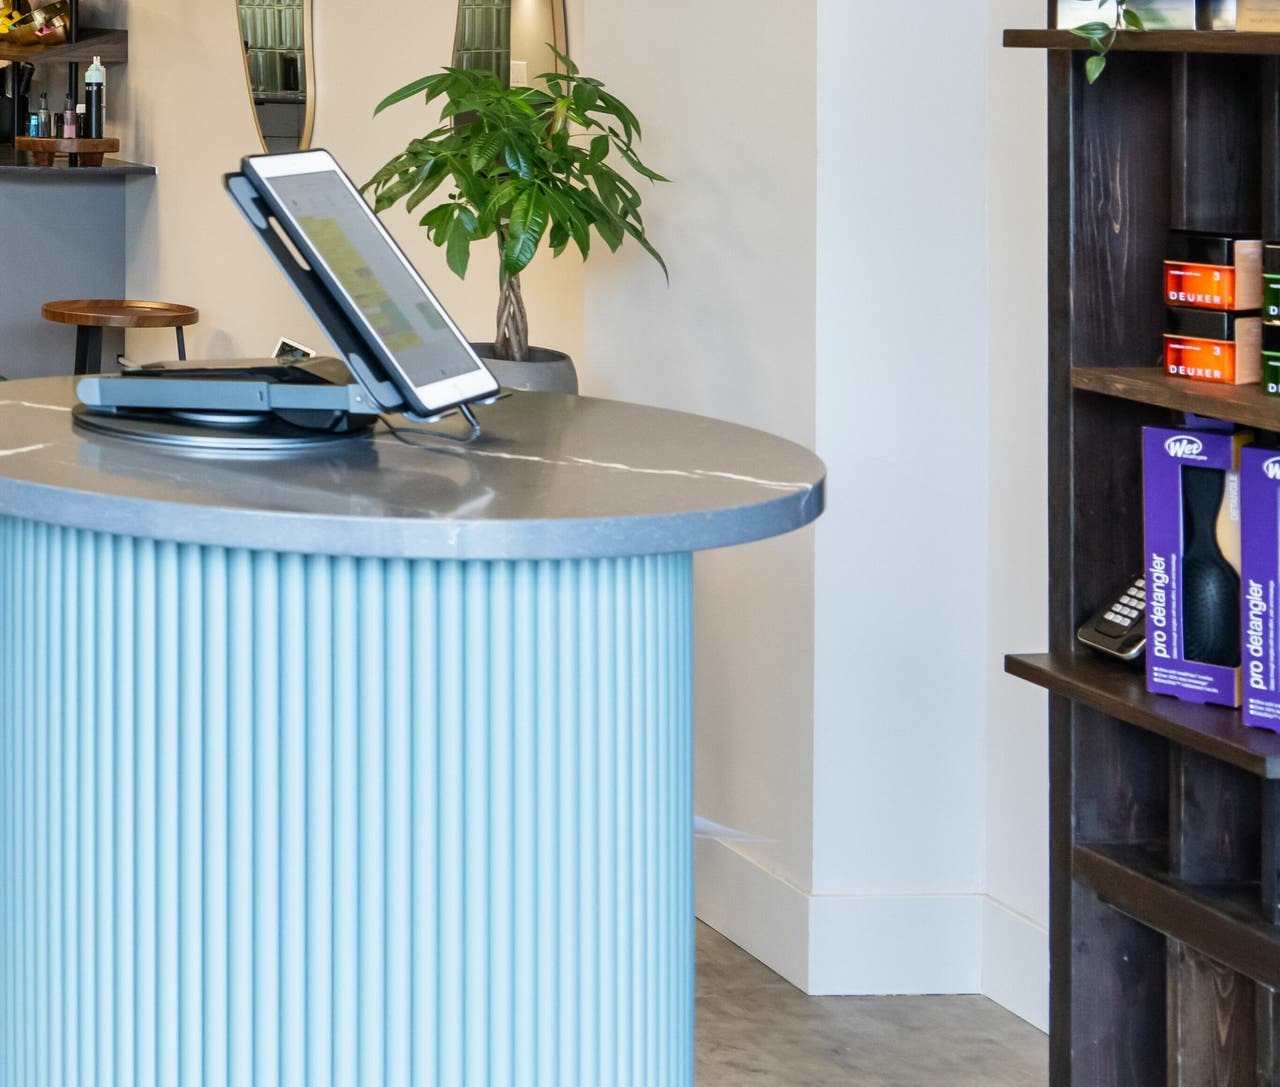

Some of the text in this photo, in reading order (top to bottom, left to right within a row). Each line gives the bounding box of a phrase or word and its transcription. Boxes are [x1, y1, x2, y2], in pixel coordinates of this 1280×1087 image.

[1213, 271, 1221, 281] 3
[1169, 291, 1222, 304] DEUXER
[1213, 346, 1221, 356] 3
[1169, 365, 1222, 379] DEUXER
[1168, 439, 1199, 458] Wet
[1149, 553, 1171, 659] pro detangler
[1245, 579, 1267, 657] detangler
[1249, 660, 1268, 690] pro
